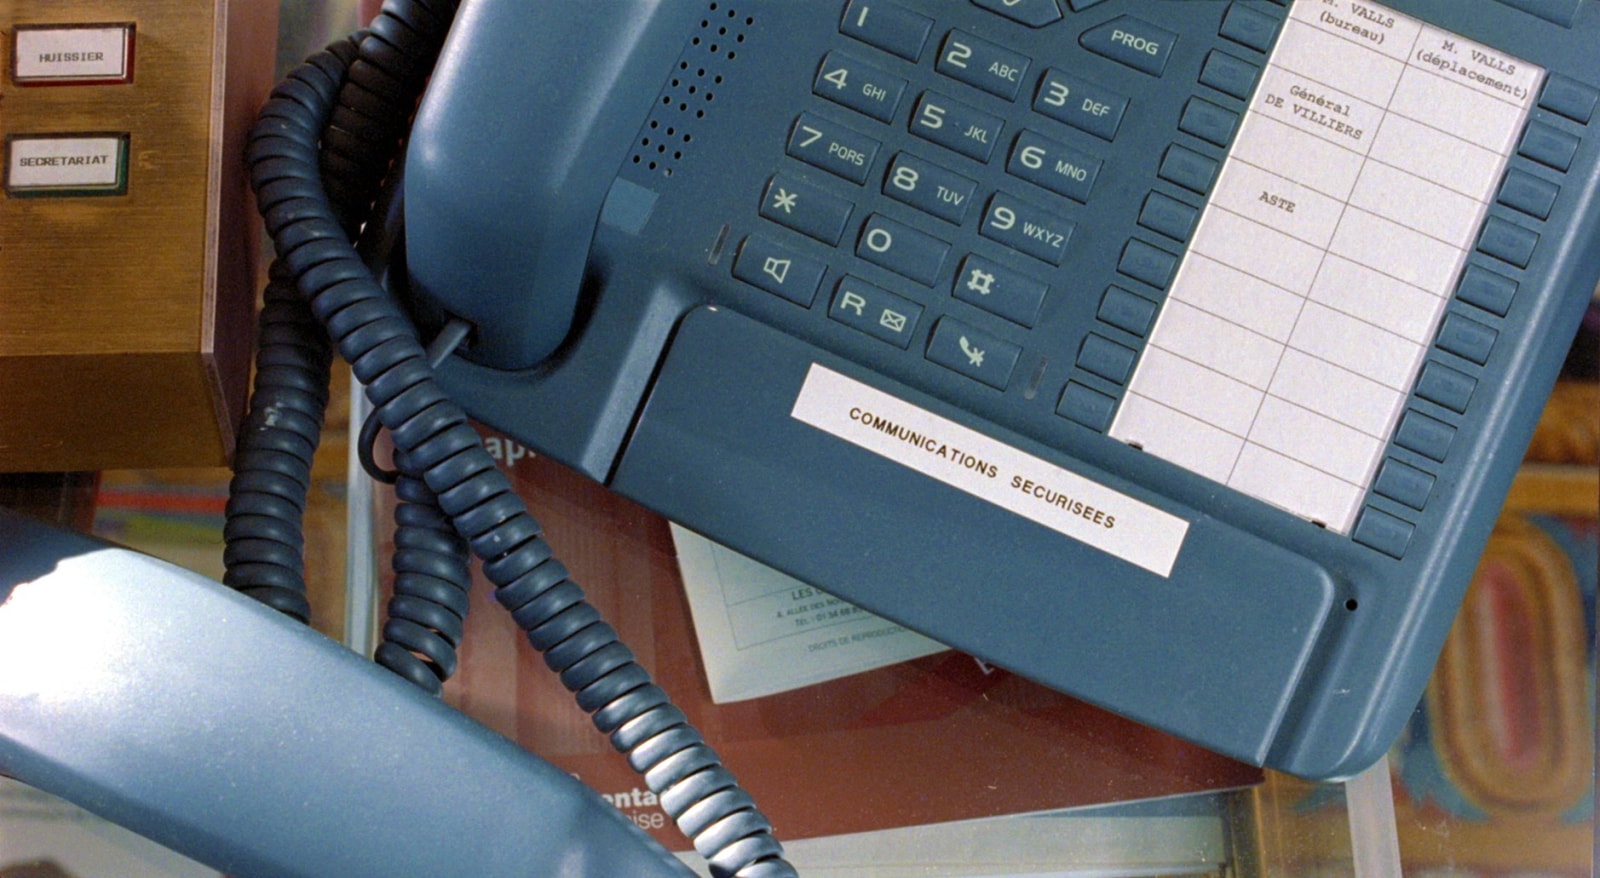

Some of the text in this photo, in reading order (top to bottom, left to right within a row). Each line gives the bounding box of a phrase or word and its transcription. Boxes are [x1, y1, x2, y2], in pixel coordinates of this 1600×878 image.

[856, 6, 869, 26] 1
[1319, 10, 1386, 45] (bureau)
[1350, 3, 1396, 29] VALLS
[38, 51, 105, 63] HUISSIER
[1111, 30, 1158, 56] PROG
[1441, 39, 1516, 76] M. VALLS
[946, 43, 1019, 82] 2 ABC
[1415, 48, 1529, 101] (déplacement)
[824, 69, 887, 102] 4 GHI
[1043, 82, 1111, 117] 3 DEF
[1289, 85, 1352, 118] Général
[919, 105, 989, 144] 5 JKL
[1265, 94, 1364, 140] DE VILLIERS
[19, 154, 109, 167] SECRETARIAT
[799, 126, 866, 167] 7 PQRS
[1020, 146, 1088, 182] 6 MNO
[893, 166, 964, 206] 8 TUV
[1258, 191, 1296, 214] ASTE
[991, 207, 1065, 248] 9 WXYZ
[840, 293, 867, 316] R
[848, 406, 1117, 530] COMMUNICATIONS SECURISEES
[626, 810, 664, 829] ise
